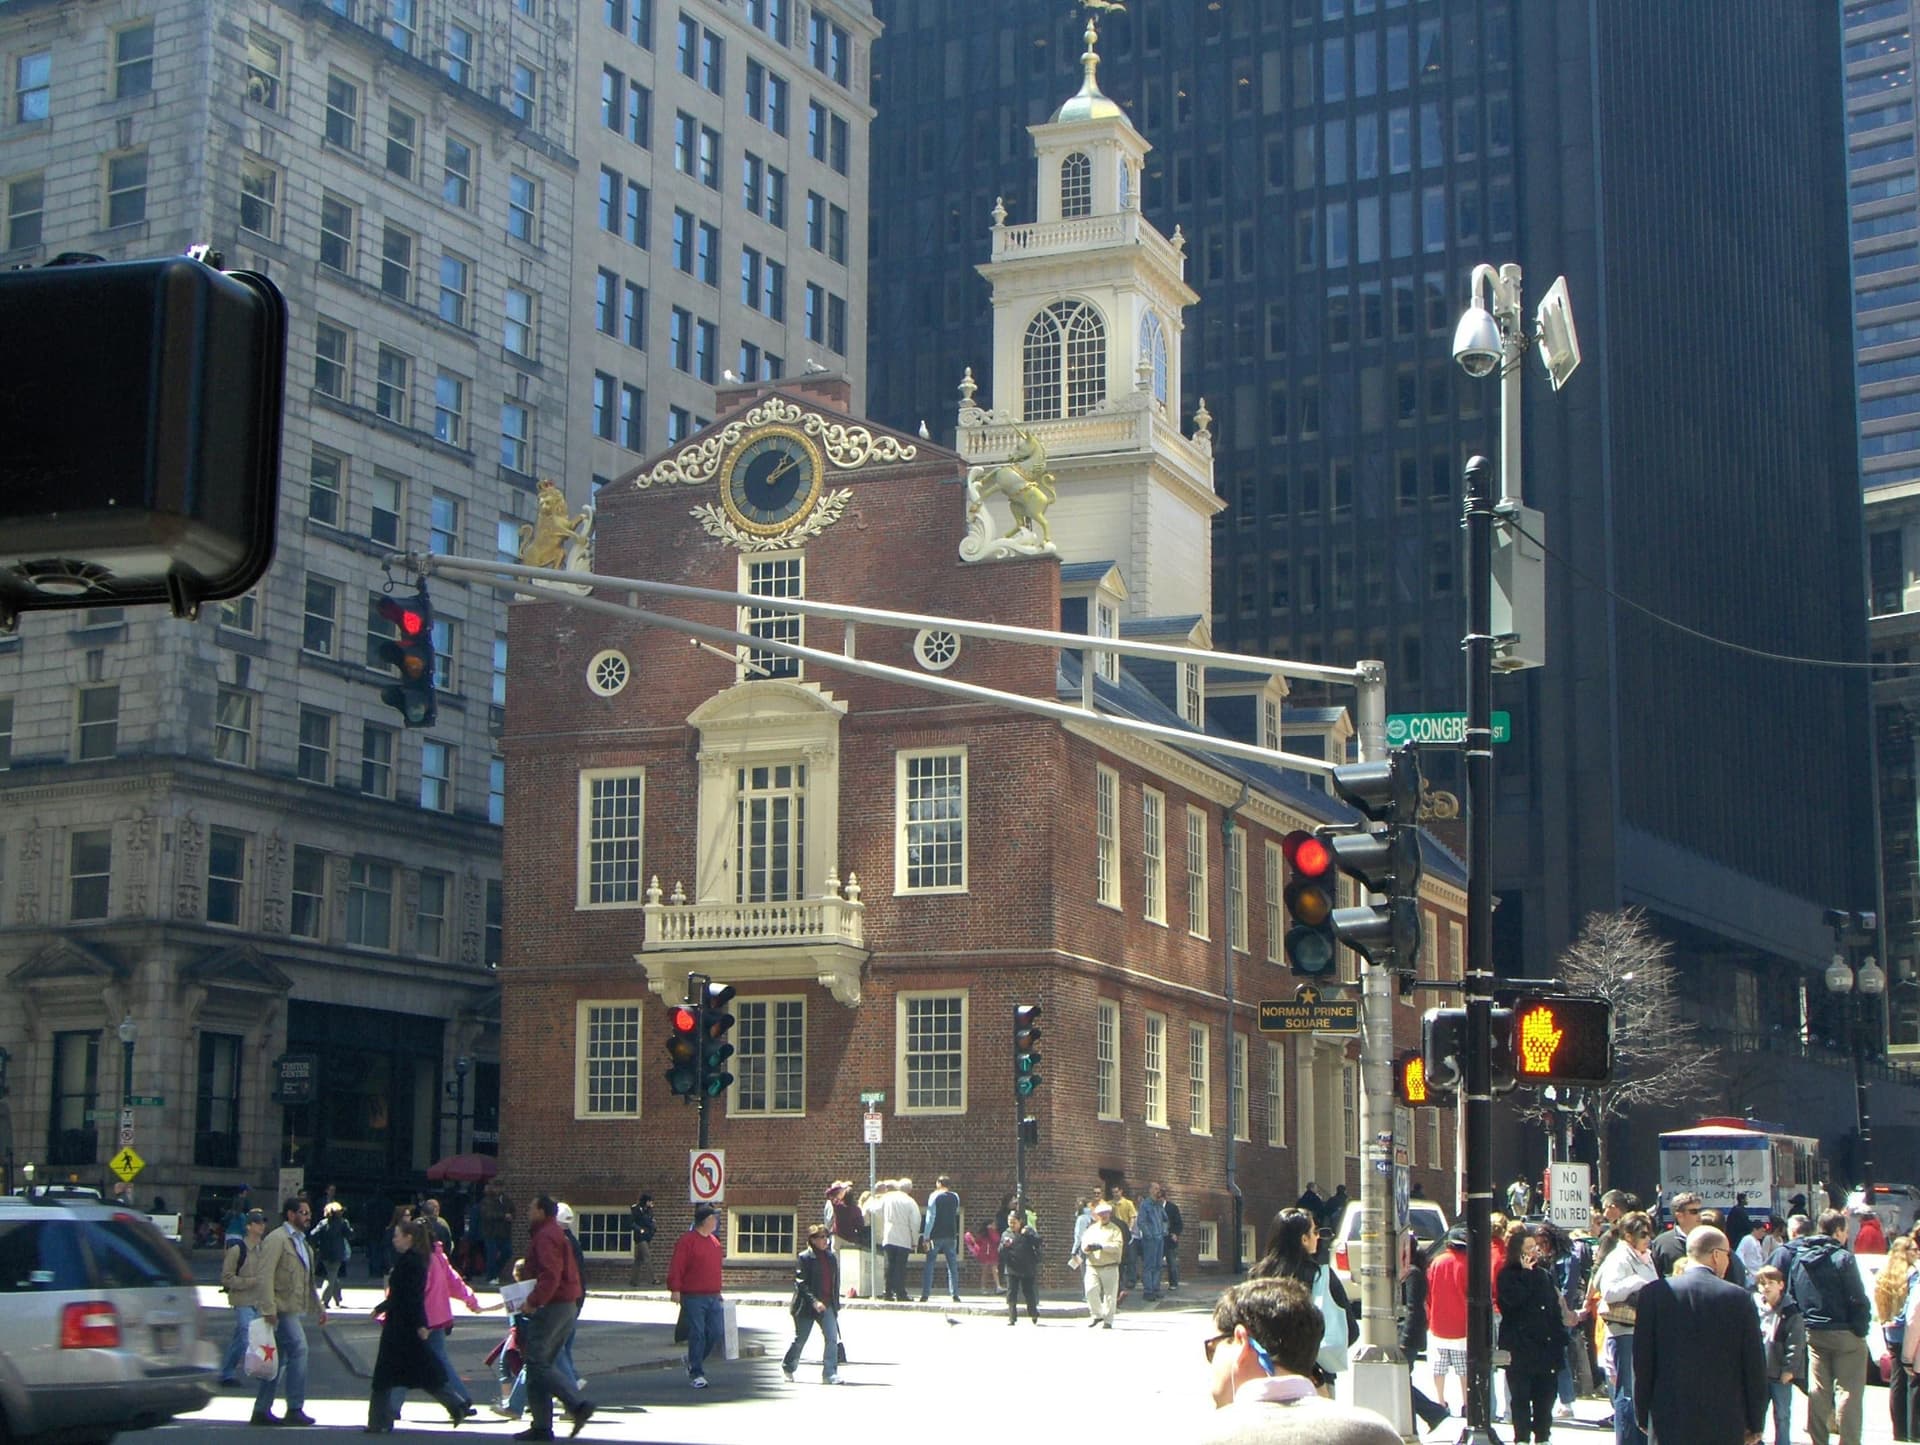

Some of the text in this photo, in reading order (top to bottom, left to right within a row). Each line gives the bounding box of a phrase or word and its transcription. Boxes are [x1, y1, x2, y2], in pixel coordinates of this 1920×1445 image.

[1410, 717, 1504, 740] CONGRE ST
[1262, 1007, 1354, 1017] NORMAN PRINCE
[1285, 1018, 1331, 1028] SQUARE
[1691, 1154, 1735, 1167] 21214
[1563, 1171, 1578, 1184] NO
[1559, 1189, 1583, 1202] TURN
[1713, 1189, 1763, 1201] ORIETED
[1554, 1207, 1588, 1220] ON RED
